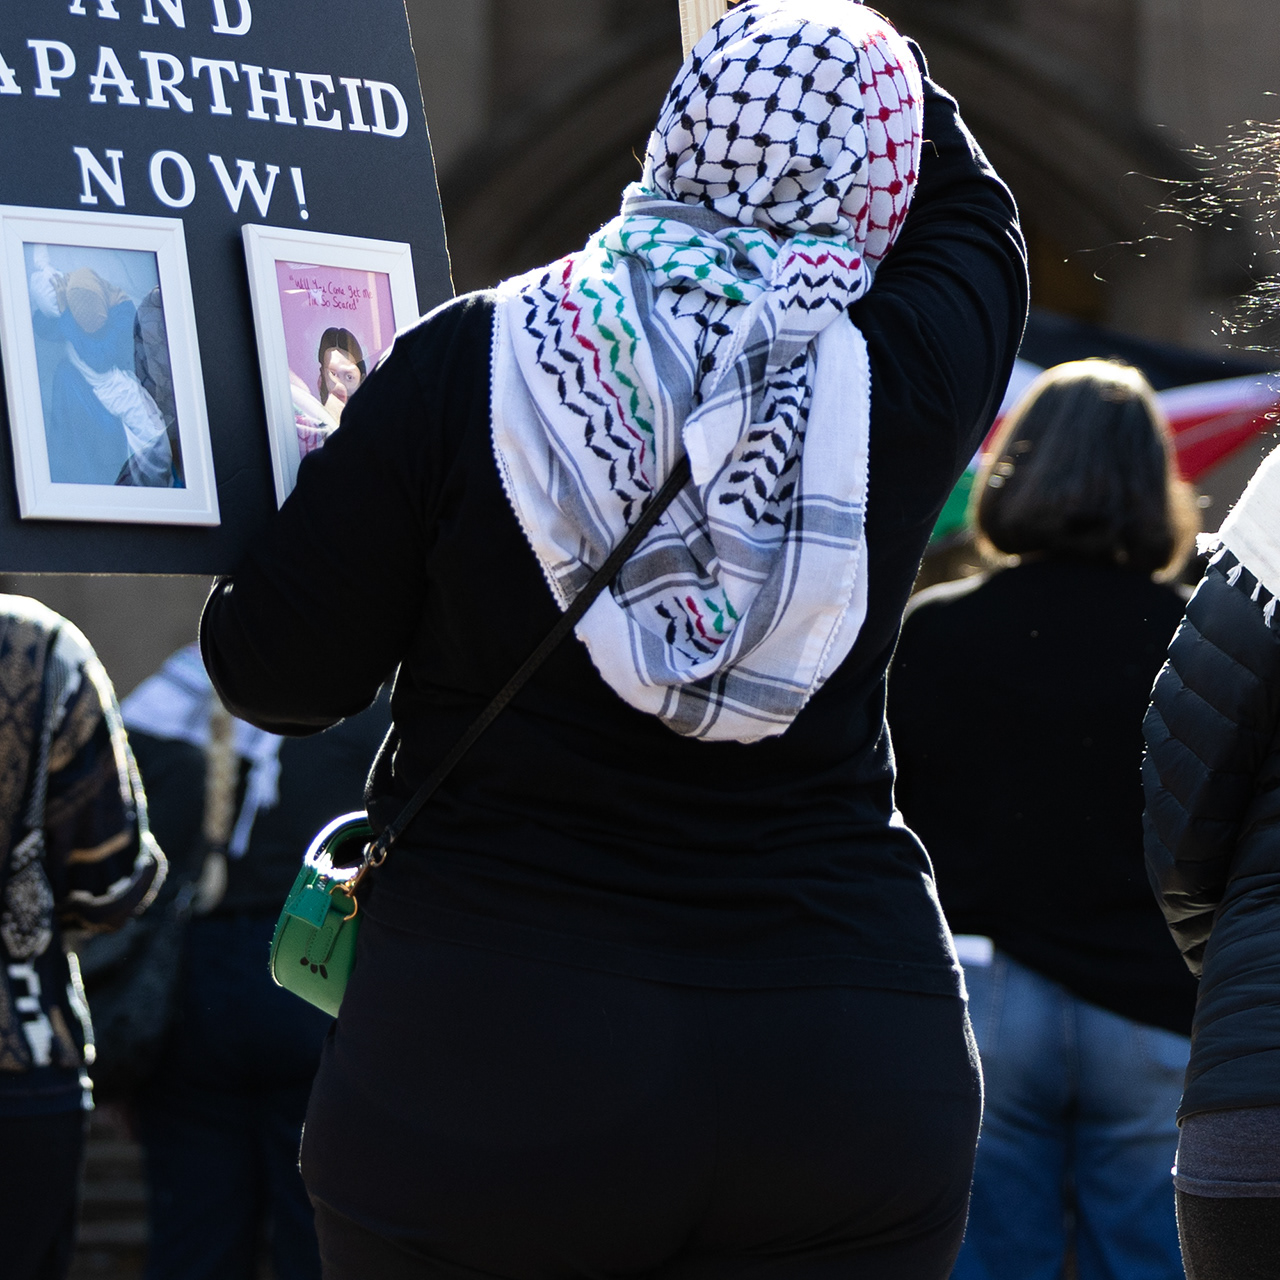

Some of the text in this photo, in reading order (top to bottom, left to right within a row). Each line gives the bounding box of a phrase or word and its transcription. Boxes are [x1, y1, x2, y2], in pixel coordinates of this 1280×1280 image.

[74, 147, 309, 220] NOW!
[327, 281, 346, 296] Come
[307, 292, 320, 307] Im
[320, 294, 330, 308] So
